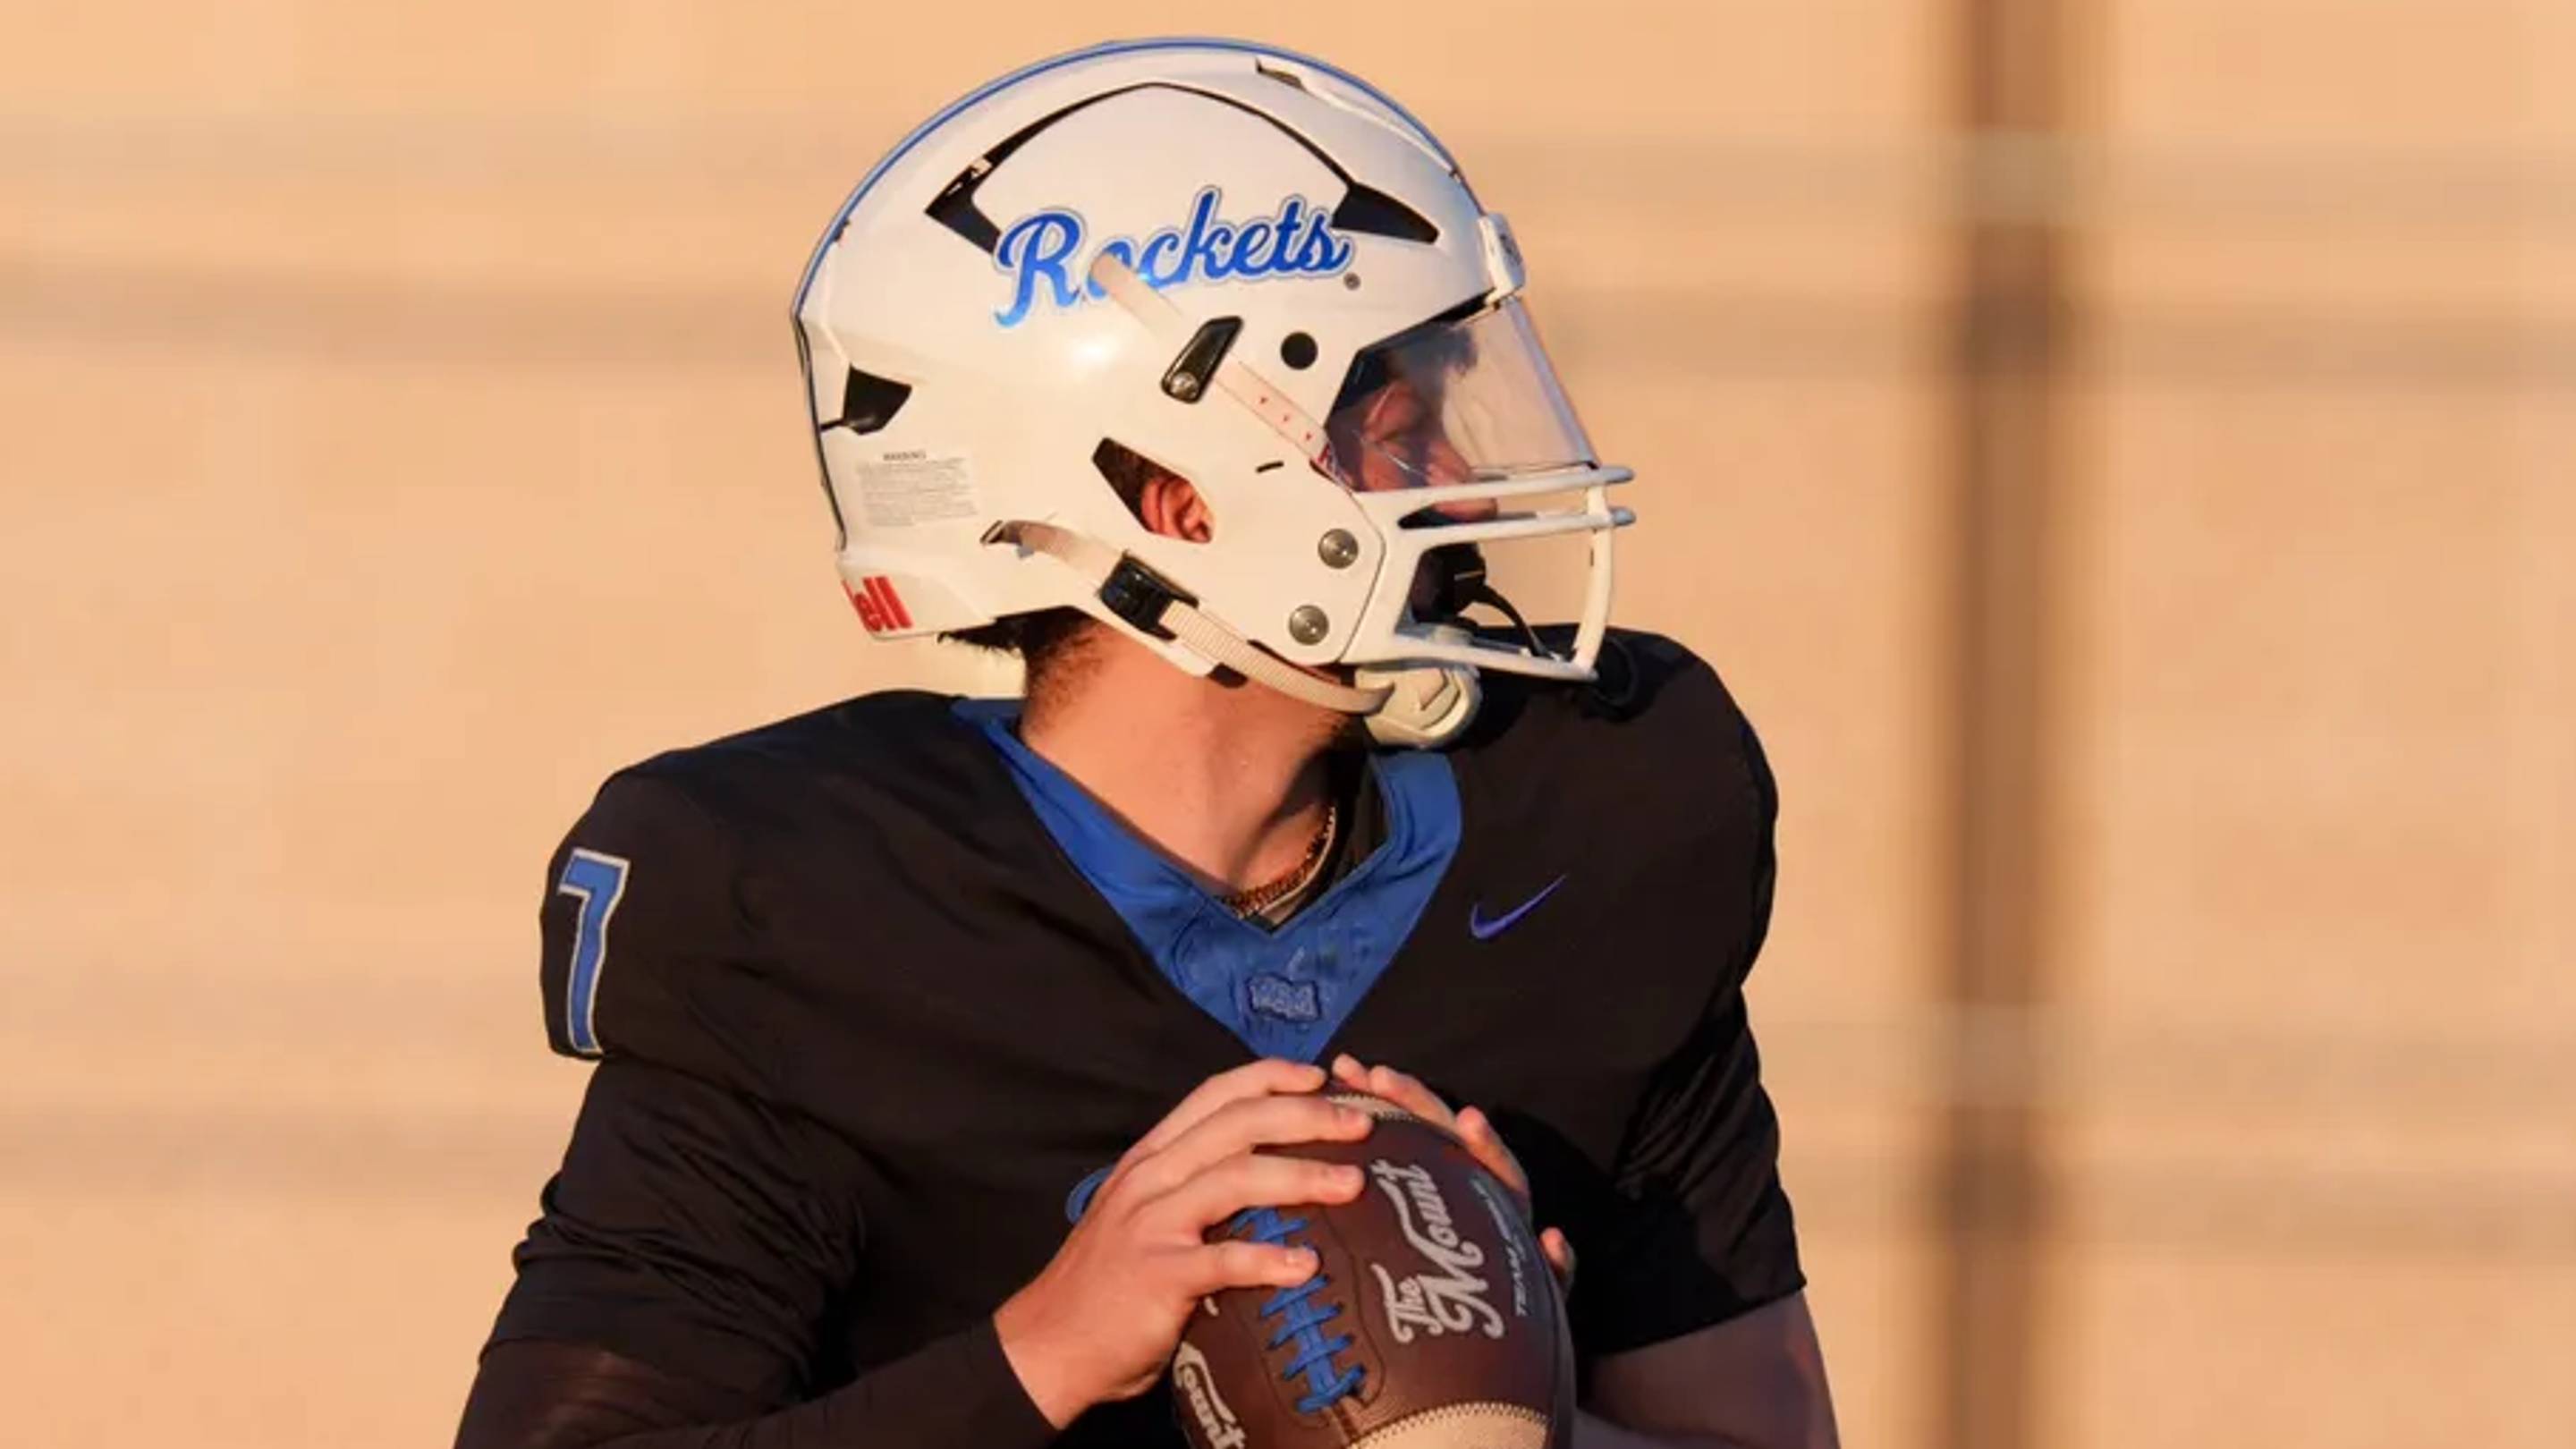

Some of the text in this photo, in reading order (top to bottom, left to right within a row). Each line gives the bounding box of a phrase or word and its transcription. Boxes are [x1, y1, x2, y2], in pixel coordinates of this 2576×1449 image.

[557, 847, 631, 1054] 7
[1371, 1159, 1505, 1340] Mount
[1371, 1263, 1444, 1343] The
